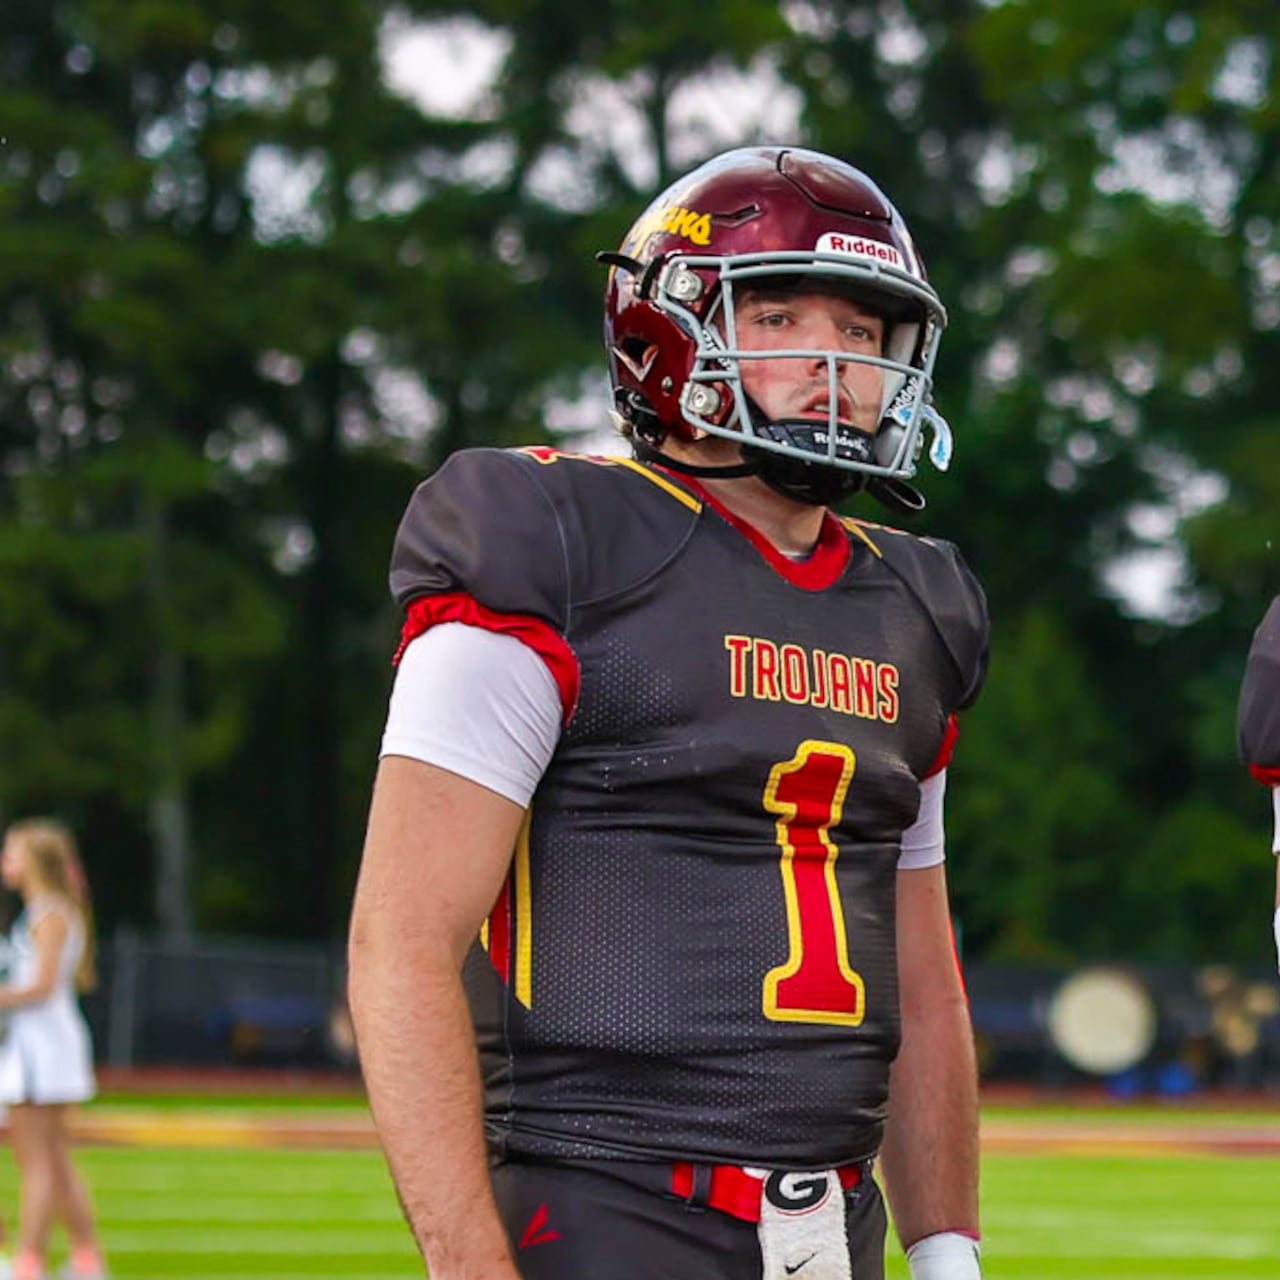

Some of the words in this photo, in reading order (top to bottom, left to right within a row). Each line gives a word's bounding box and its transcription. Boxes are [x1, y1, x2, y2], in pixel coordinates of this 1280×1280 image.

[830, 235, 898, 264] Riddell
[725, 635, 899, 724] TROJANS
[763, 739, 865, 1027] 1
